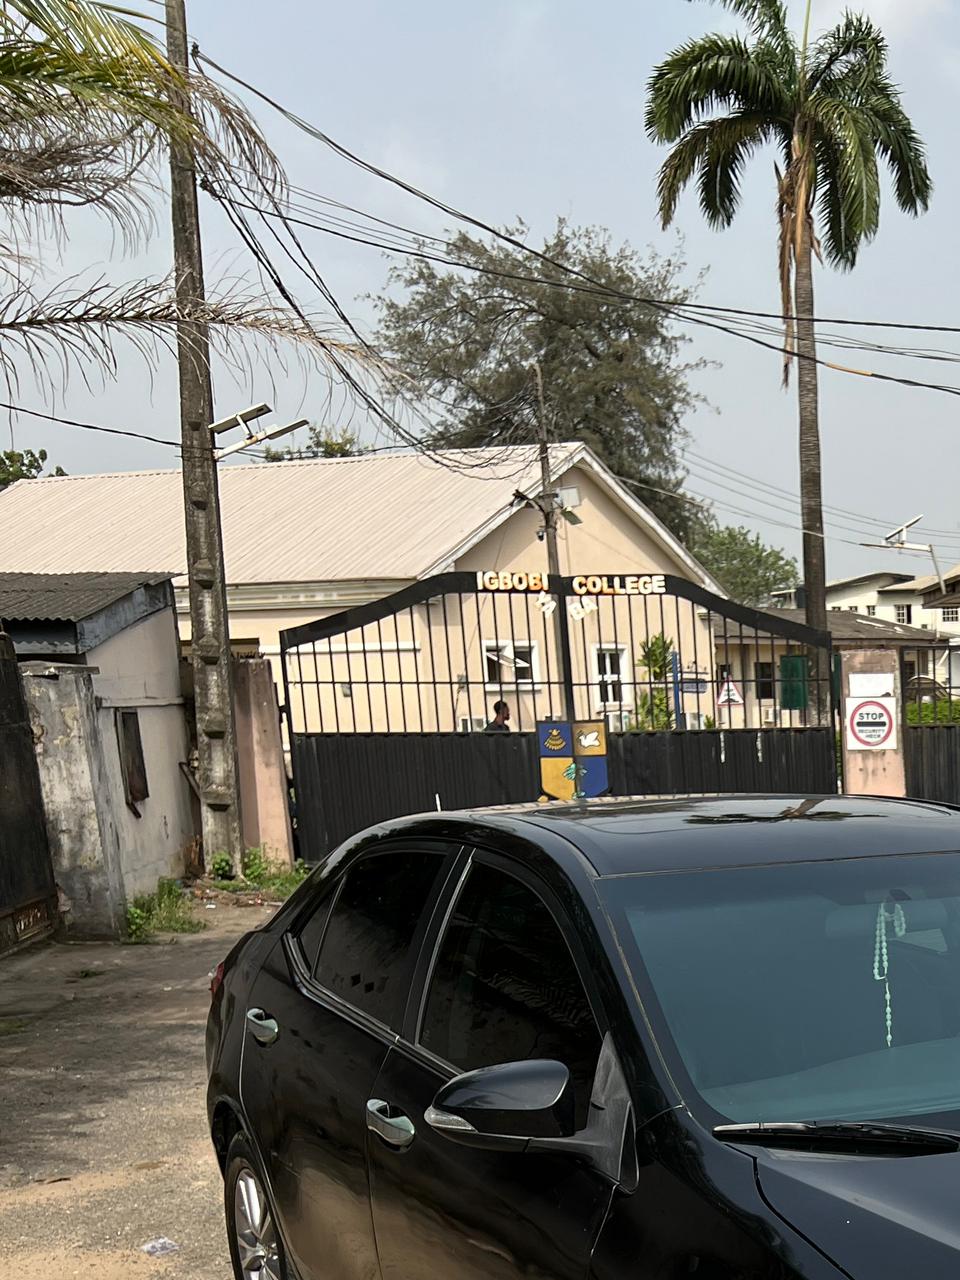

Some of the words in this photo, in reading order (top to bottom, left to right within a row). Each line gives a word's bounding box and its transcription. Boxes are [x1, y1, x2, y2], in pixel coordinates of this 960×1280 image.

[476, 571, 549, 591] IGBOBI
[572, 575, 666, 595] COLLEGE
[858, 712, 884, 721] STOP
